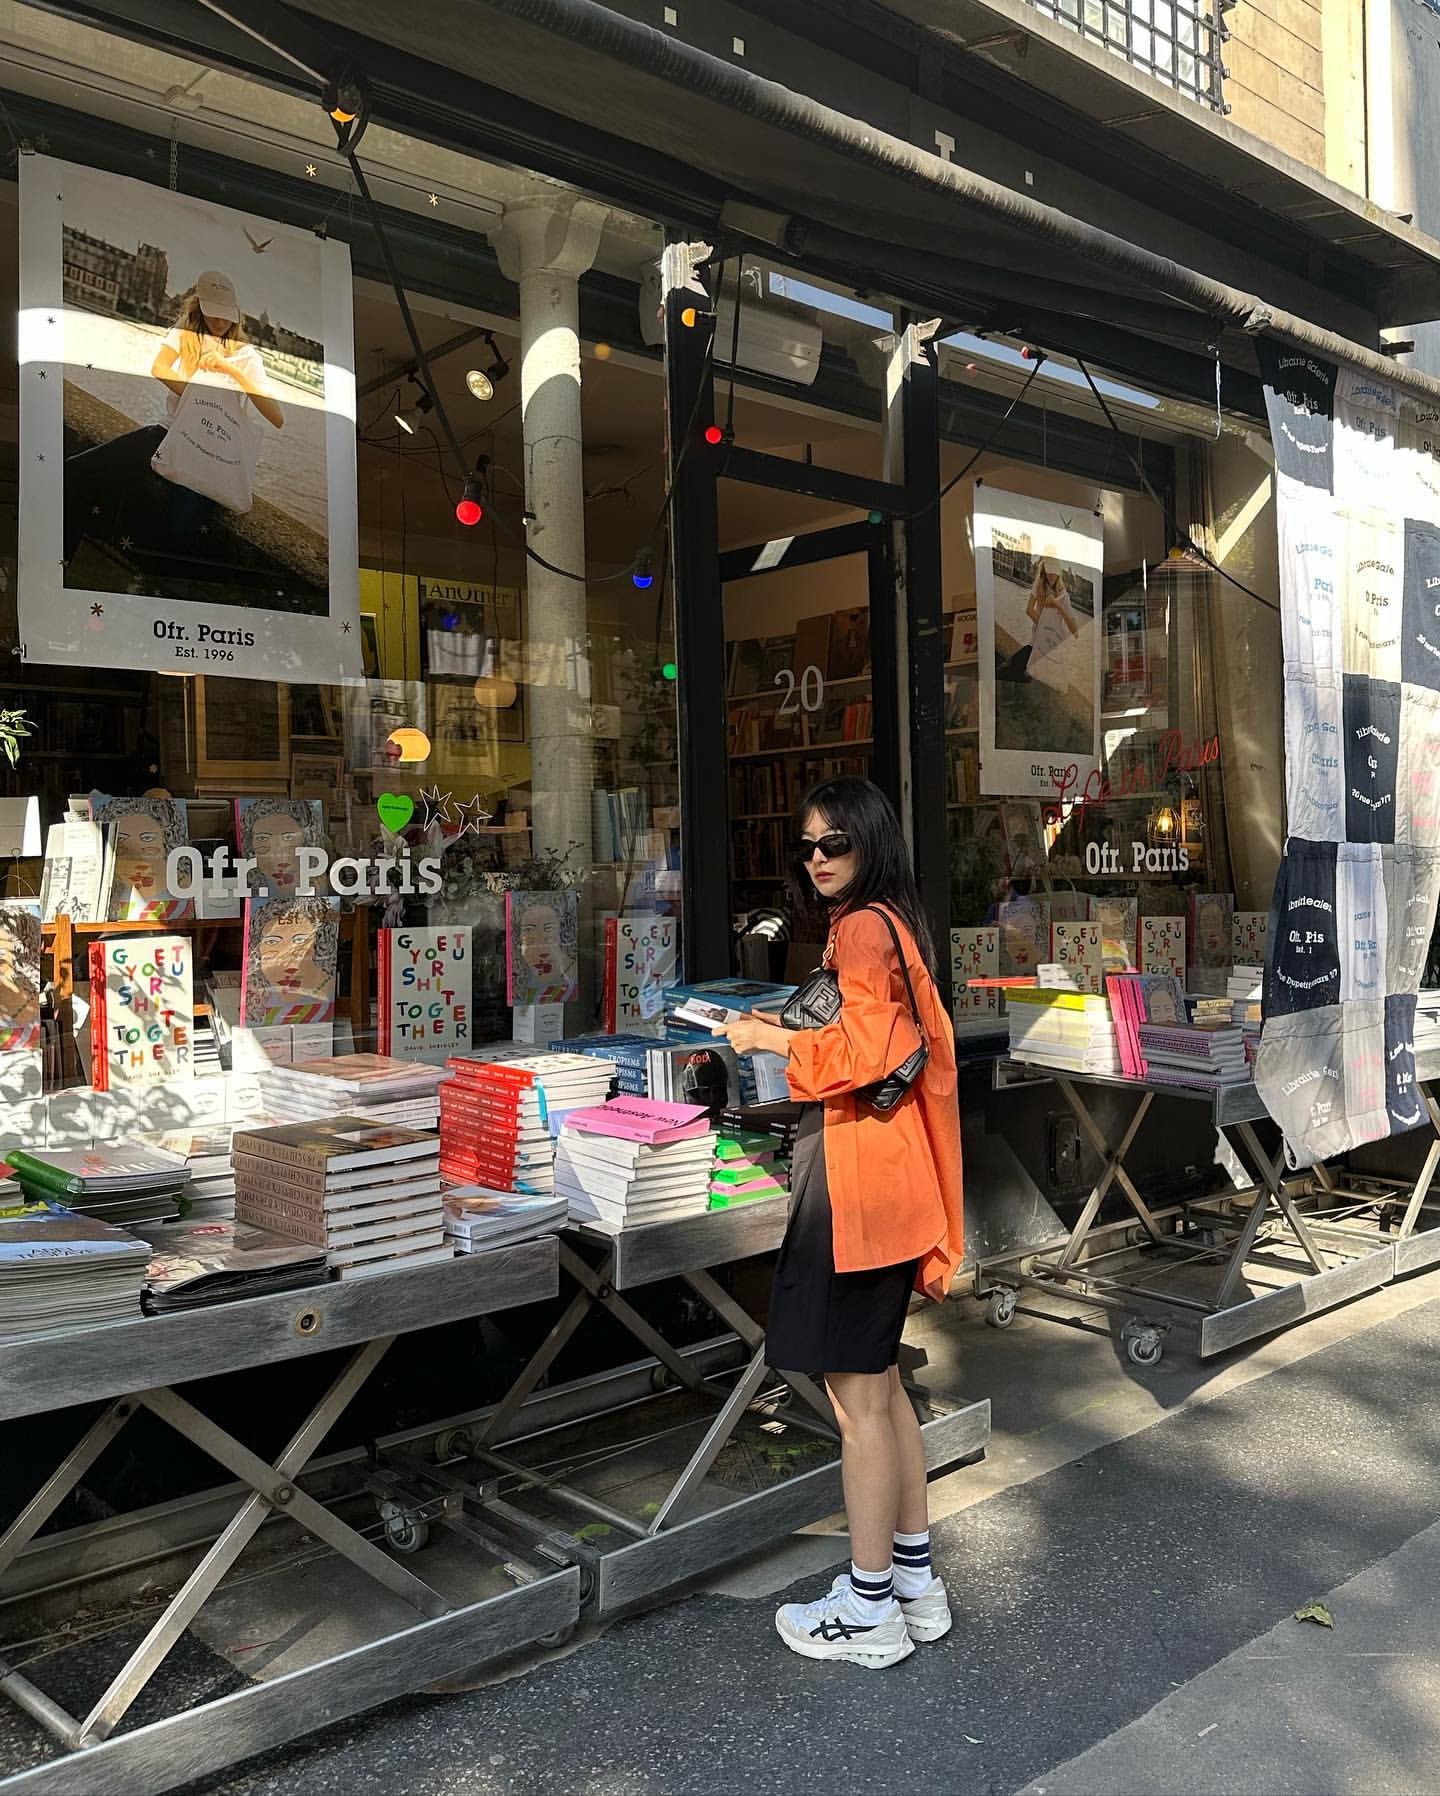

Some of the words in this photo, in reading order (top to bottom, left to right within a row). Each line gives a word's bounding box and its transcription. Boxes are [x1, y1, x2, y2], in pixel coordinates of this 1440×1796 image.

[198, 624, 255, 646] Paris
[175, 646, 199, 659] Est.
[204, 648, 235, 661] 1996
[774, 665, 824, 715] 20
[295, 846, 444, 897] Paris
[1131, 841, 1190, 873] Paris
